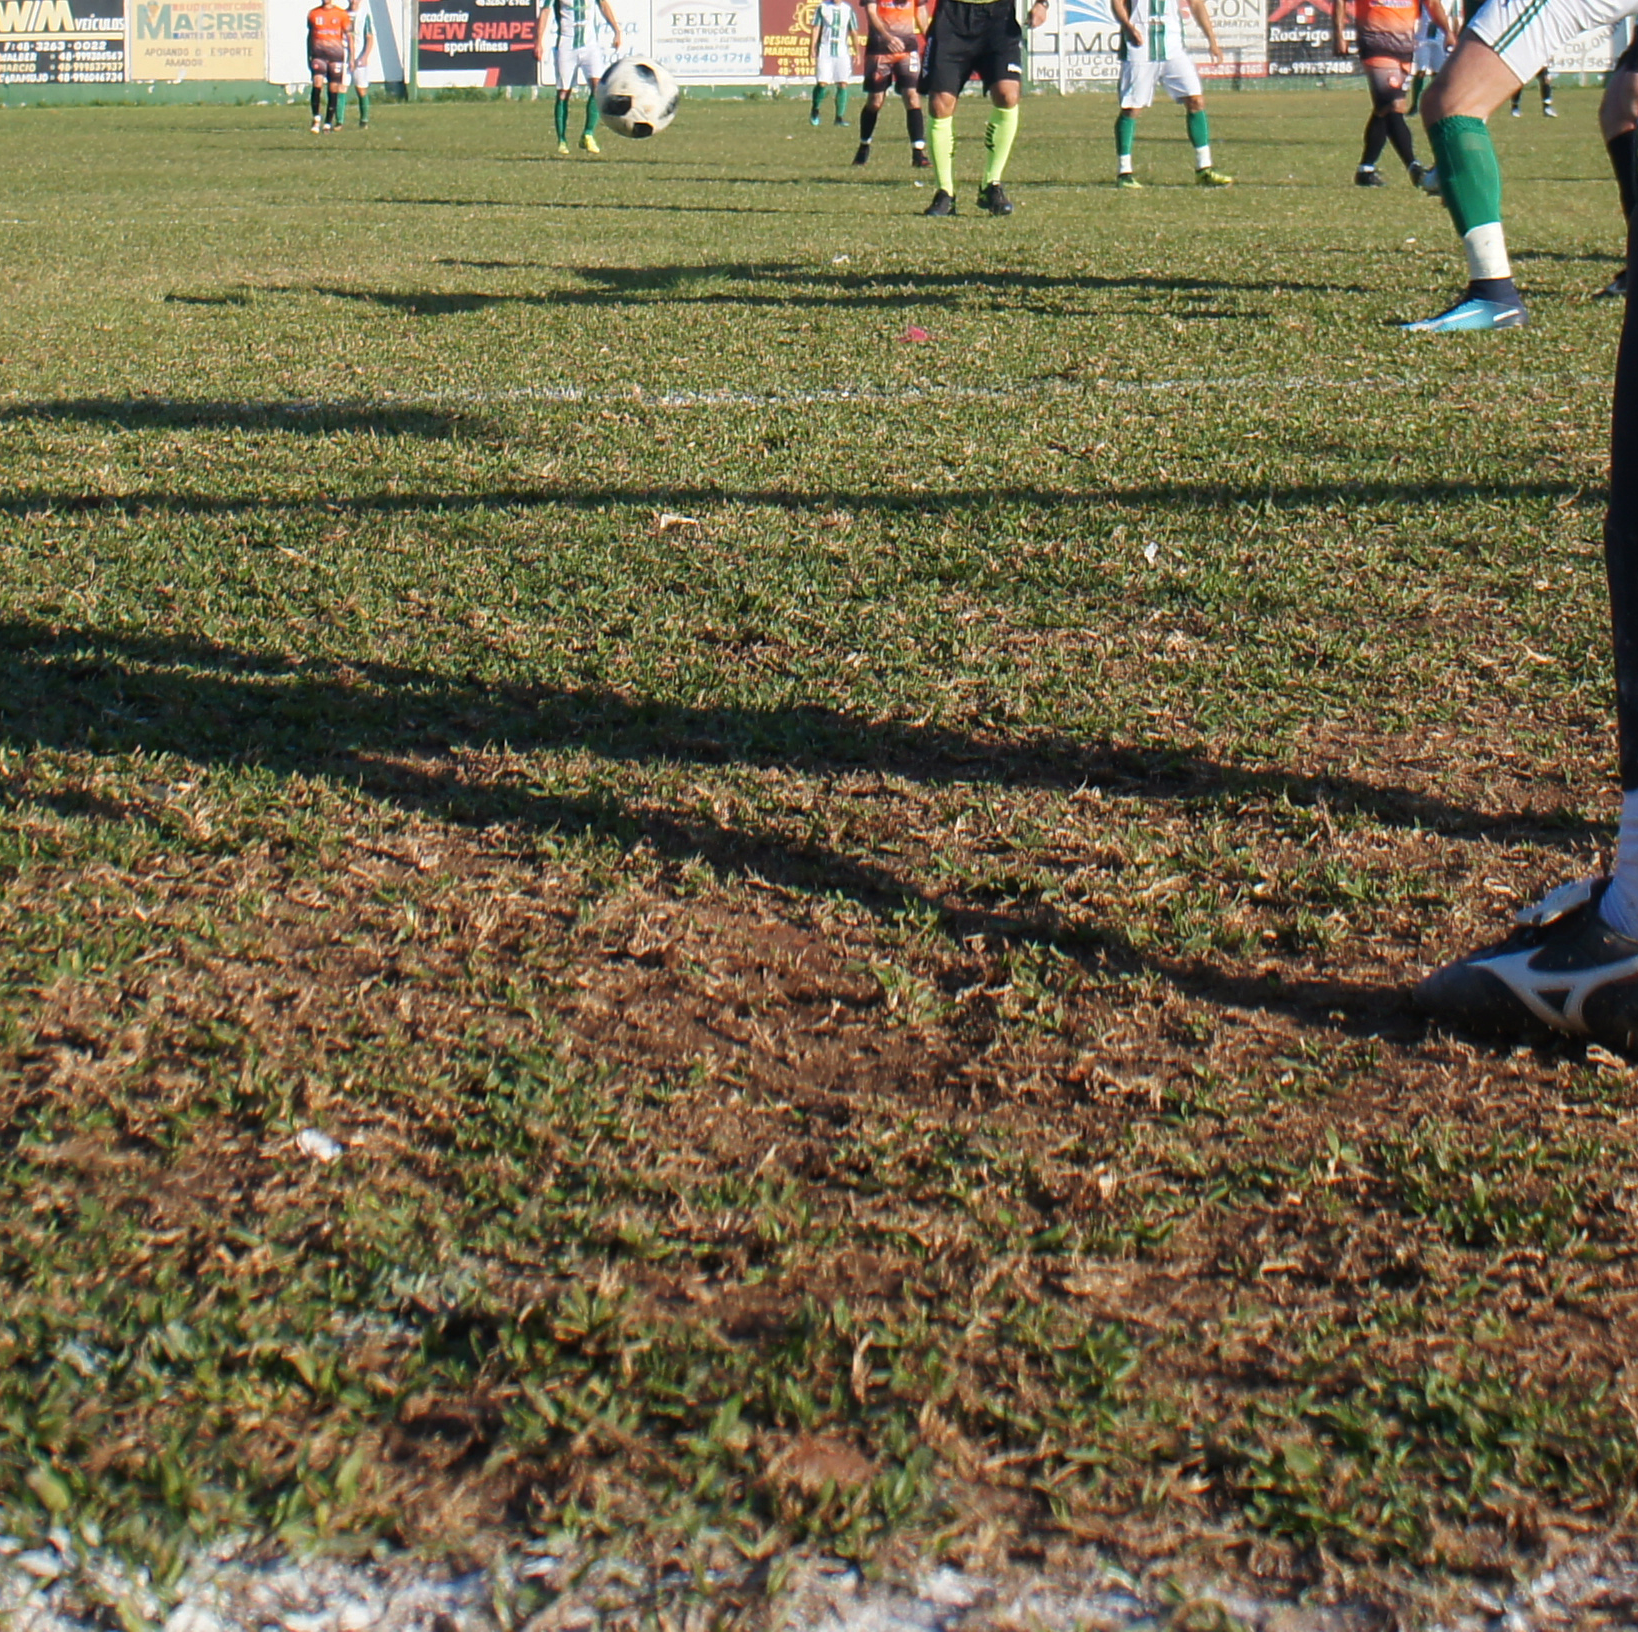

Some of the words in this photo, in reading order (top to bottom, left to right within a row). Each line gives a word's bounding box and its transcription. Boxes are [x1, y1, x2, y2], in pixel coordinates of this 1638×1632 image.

[419, 9, 469, 23] academia
[671, 13, 738, 27] FELTZ
[419, 23, 467, 40] NEW
[472, 22, 535, 39] SHAPE
[671, 27, 737, 36] CONSTRUÇÕES
[1269, 25, 1330, 47] Rodrigo
[443, 39, 473, 57] sport
[474, 38, 508, 52] fitness
[764, 36, 798, 46] DESIGN
[144, 48, 189, 57] APOIANDO
[194, 48, 202, 56] O
[210, 48, 254, 56] ESPORTE
